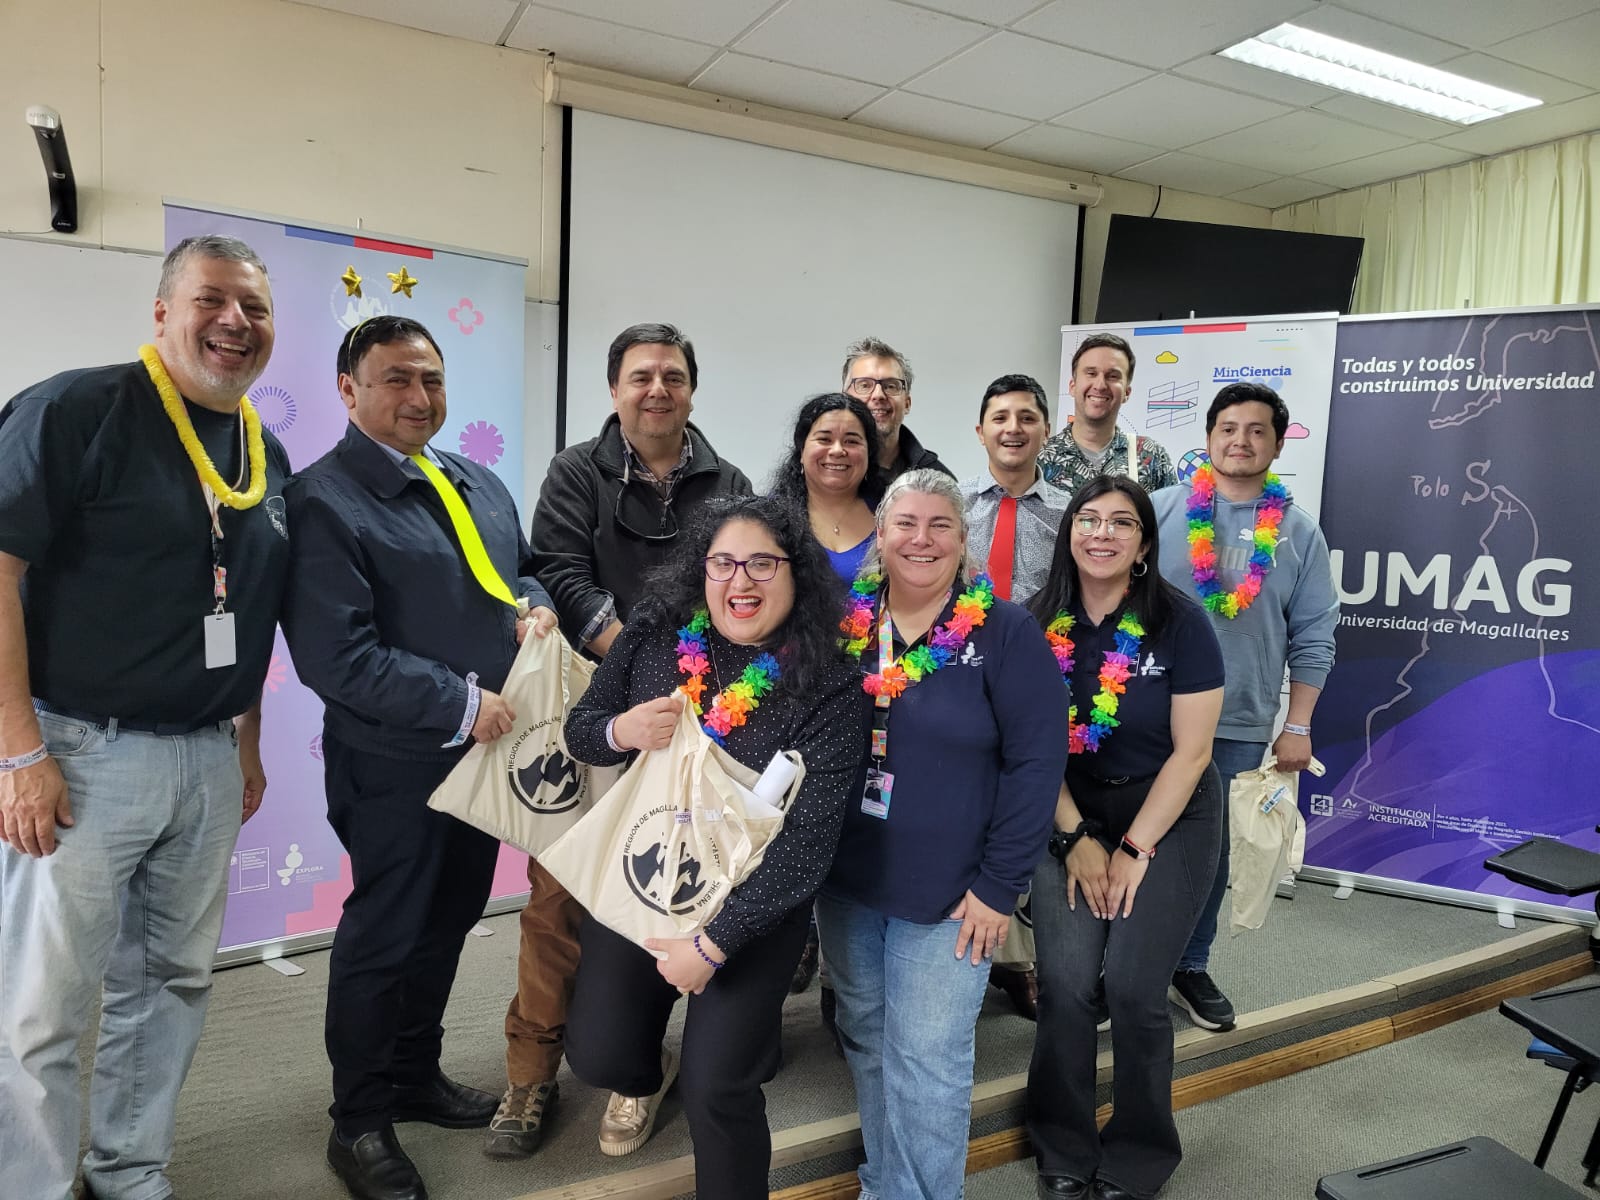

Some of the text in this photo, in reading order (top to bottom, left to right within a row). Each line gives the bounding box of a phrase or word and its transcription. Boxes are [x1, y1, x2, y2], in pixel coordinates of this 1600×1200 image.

[1212, 365, 1292, 378] MinCiencia
[1342, 353, 1476, 376] Todas y todos
[1339, 370, 1596, 394] construimos Universidad
[1408, 474, 1450, 498] Polo
[1329, 549, 1573, 617] UMAG
[1432, 619, 1455, 633] de
[1459, 620, 1570, 641] Magallanes
[519, 731, 530, 741] DE
[639, 813, 649, 825] DE
[1367, 813, 1429, 828] ACREDITADA
[1369, 804, 1431, 820] INSTITUCIÓN
